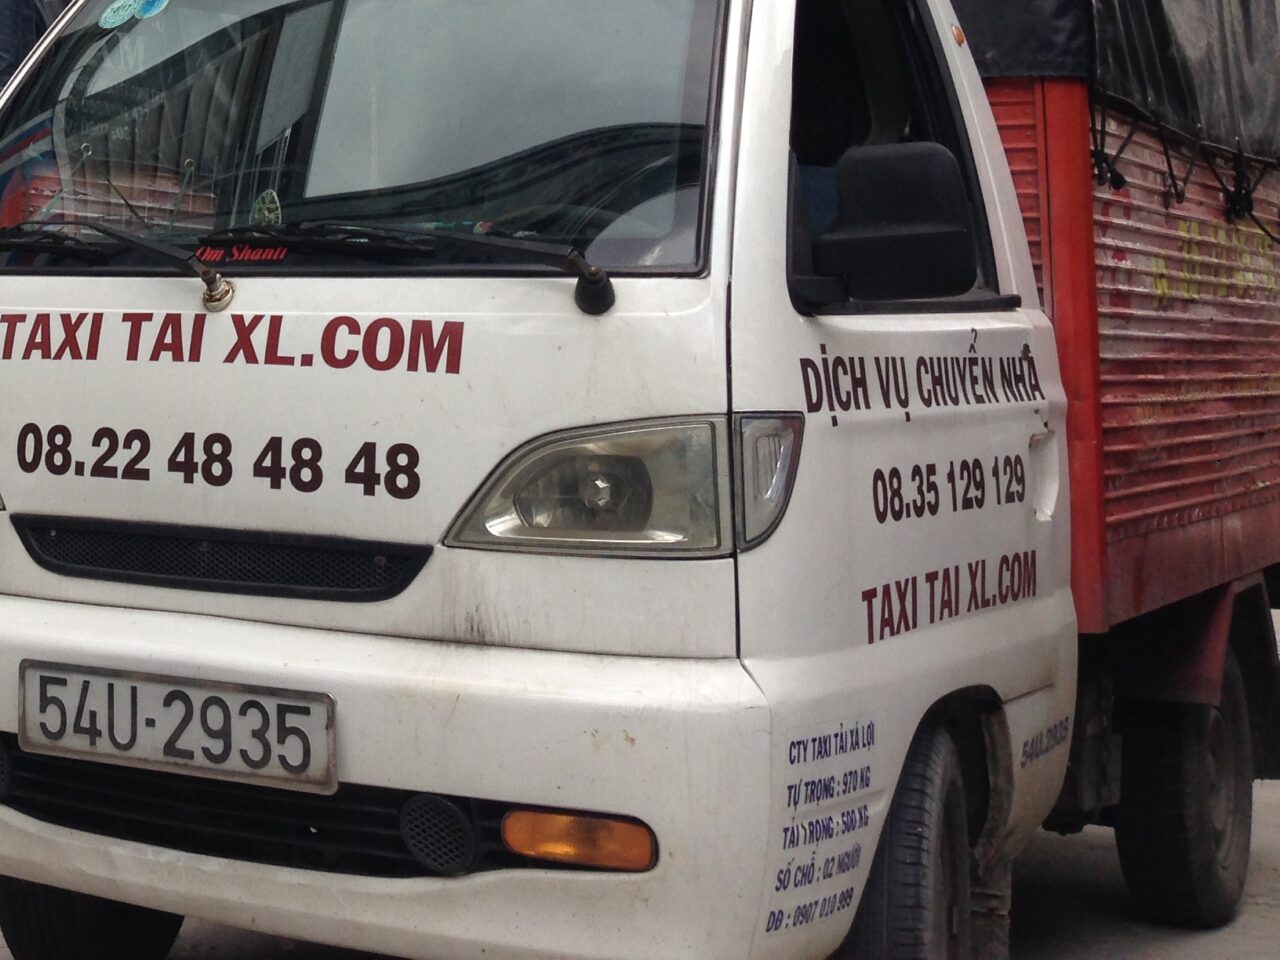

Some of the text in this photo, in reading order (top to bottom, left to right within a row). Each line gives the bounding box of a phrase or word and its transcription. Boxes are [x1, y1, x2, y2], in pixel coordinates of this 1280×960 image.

[0, 312, 465, 375] TAXI TAI XL.COM
[874, 356, 911, 422] VỤ
[915, 328, 1000, 408] CHUYỂN
[16, 422, 421, 500] 08.22 48 48 48
[872, 453, 1026, 525] 08.35 129 129
[861, 549, 1038, 645] TAXI TAI XL.COM
[788, 739, 809, 766] CTY
[811, 734, 832, 761] TAXI
[833, 722, 848, 756] TẢI
[849, 720, 860, 753] XÁ
[804, 775, 835, 807] TRỌNG
[842, 769, 859, 796] 970
[859, 765, 871, 790] KG
[782, 815, 800, 850] TẢI
[857, 804, 869, 829] KG
[822, 855, 836, 880] 02
[792, 899, 819, 928] 0907
[819, 893, 837, 919] 010
[836, 886, 854, 912] 999
